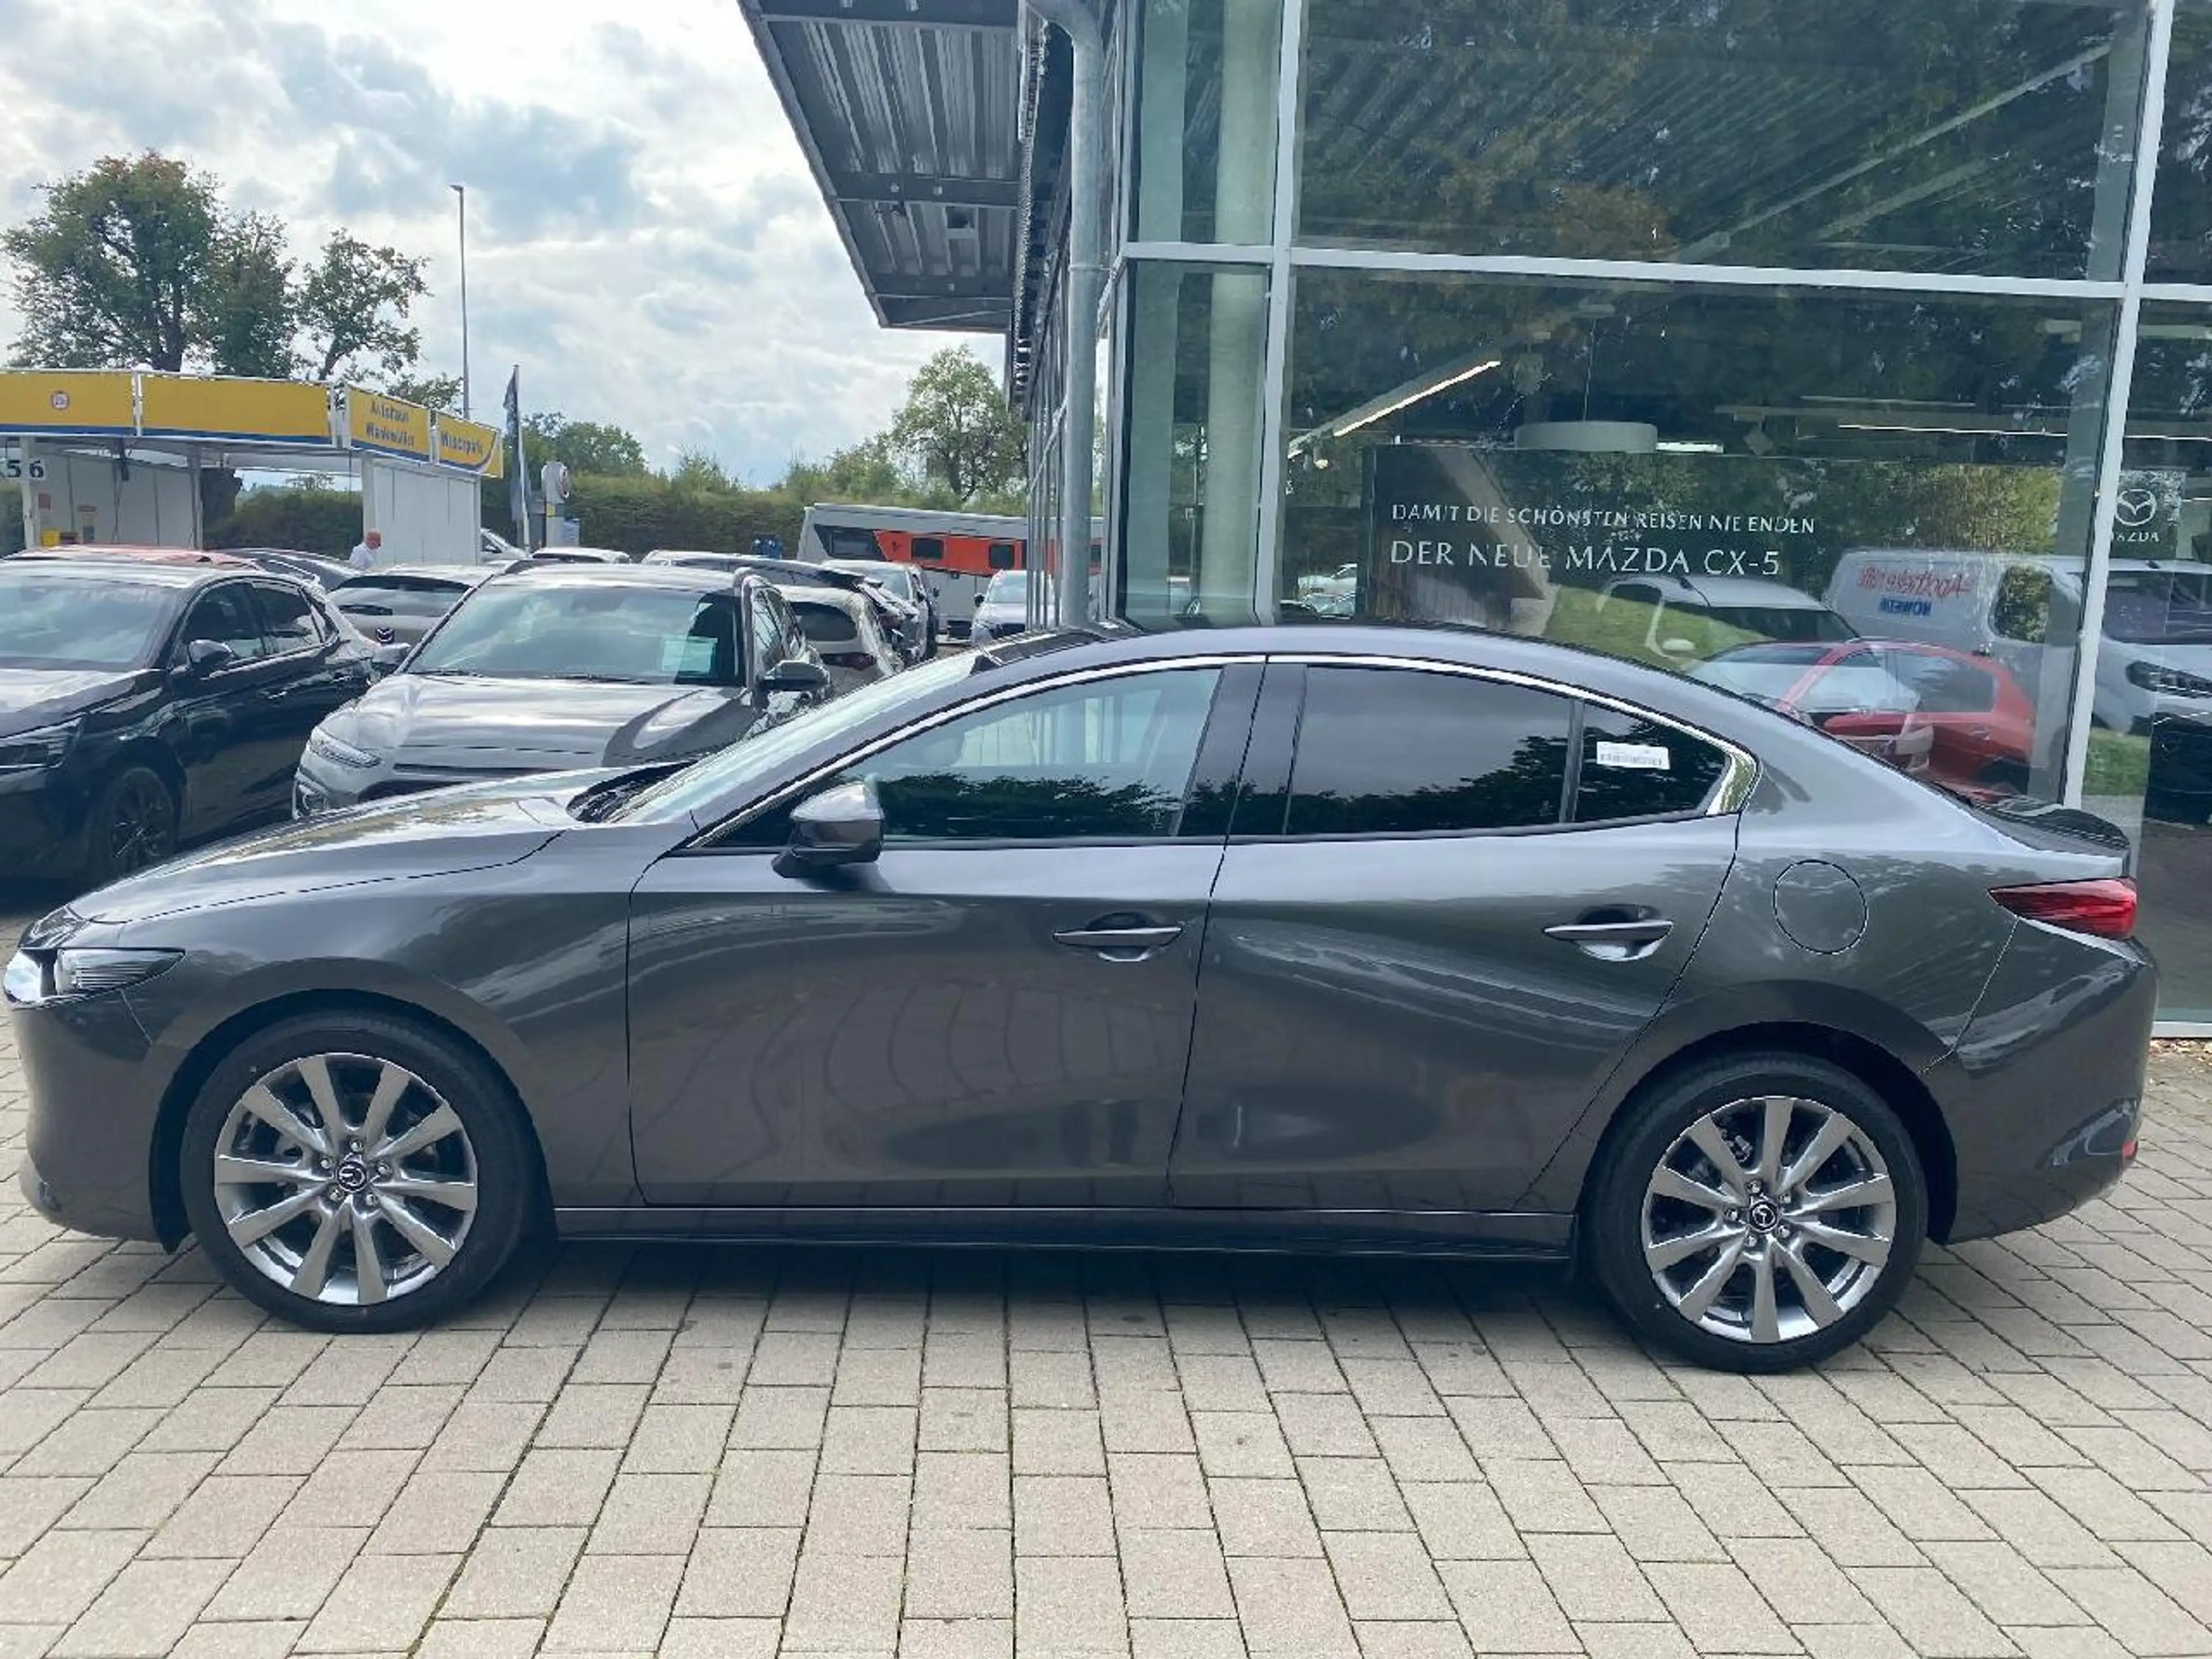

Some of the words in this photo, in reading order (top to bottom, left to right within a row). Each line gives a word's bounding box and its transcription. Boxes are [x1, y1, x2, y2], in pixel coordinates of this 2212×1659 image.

[6, 460, 21, 478] 5
[29, 460, 44, 478] 6
[1392, 504, 1459, 520] DAMIT
[1467, 506, 1501, 523] DIE
[1508, 505, 1627, 528] SCHÖNSTEN
[1636, 512, 1702, 530] REISEN
[1709, 514, 1741, 532] NIE
[1748, 516, 1815, 533] ENDEN
[2111, 531, 2159, 542] AZDA
[1391, 540, 1455, 565] DER
[1468, 542, 1552, 569] NEUE
[1565, 546, 1690, 573] MAZDA
[1703, 549, 1779, 575] CX-5
